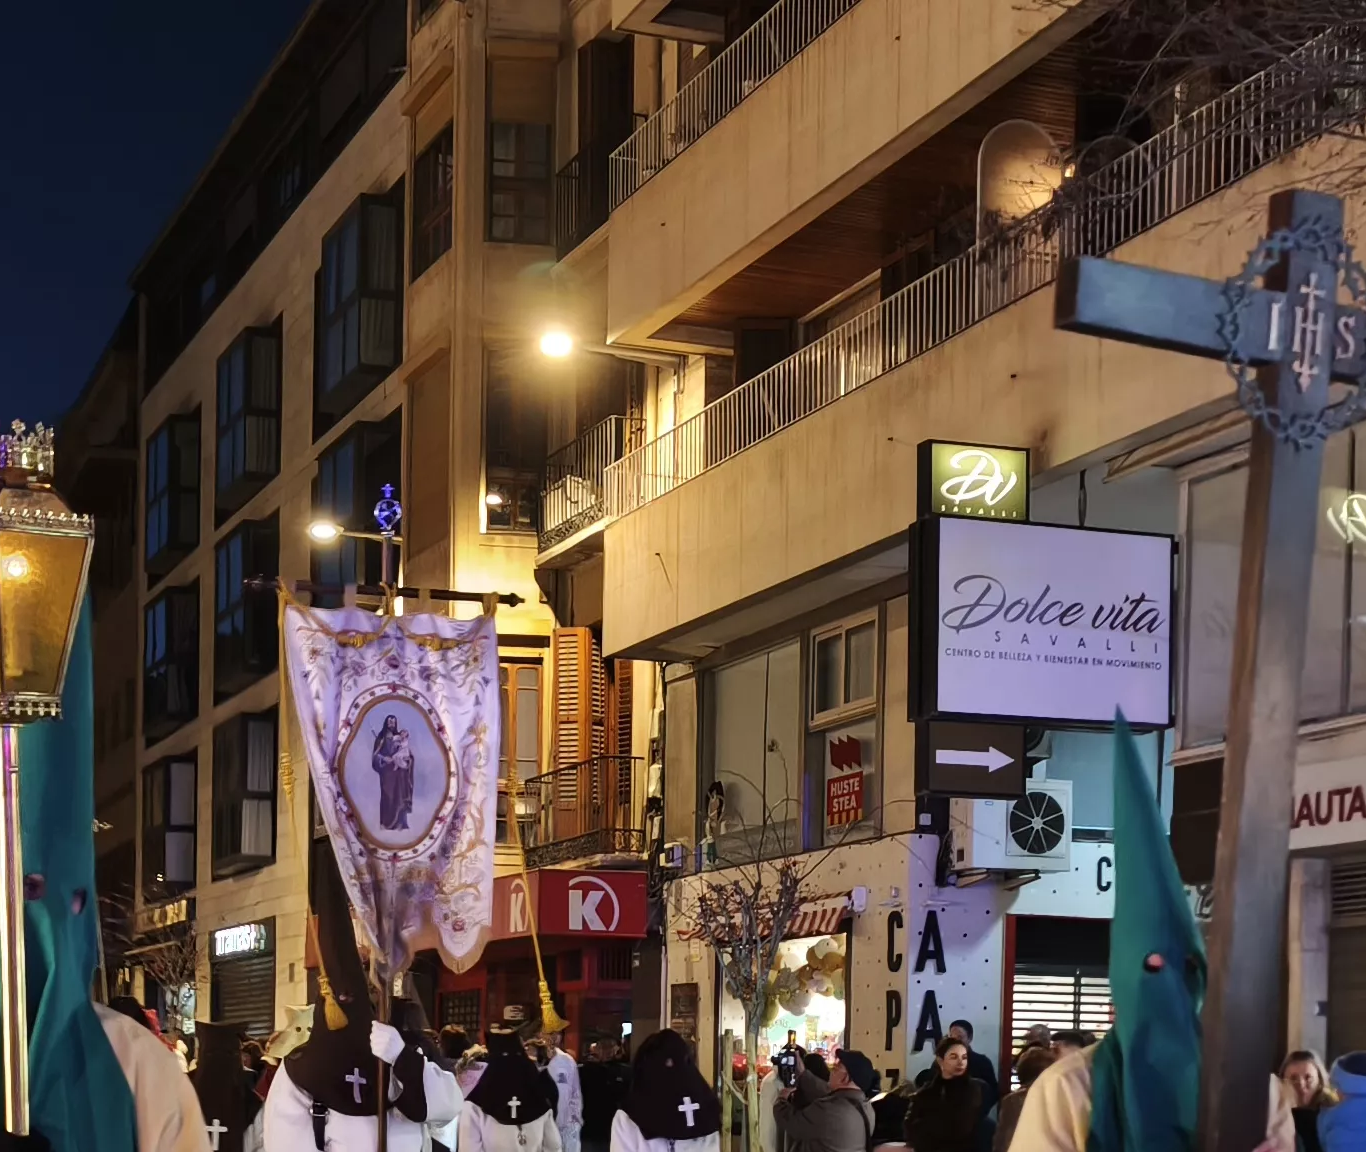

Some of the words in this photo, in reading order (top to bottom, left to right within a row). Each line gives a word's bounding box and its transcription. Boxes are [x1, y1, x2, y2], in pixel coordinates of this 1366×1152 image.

[1268, 290, 1356, 374] IHS
[941, 574, 1086, 634] Dolce
[1091, 592, 1167, 634] vita
[994, 630, 1158, 654] SAVALLI
[944, 648, 982, 659] CENTRO
[984, 650, 995, 660] DE
[998, 651, 1033, 662] BELLEZA
[1036, 654, 1041, 662] Y
[1044, 655, 1089, 666] BIENESTAR
[1092, 657, 1103, 667] EN
[1106, 659, 1162, 671] MOVIMIENTO
[833, 794, 857, 812] STEA
